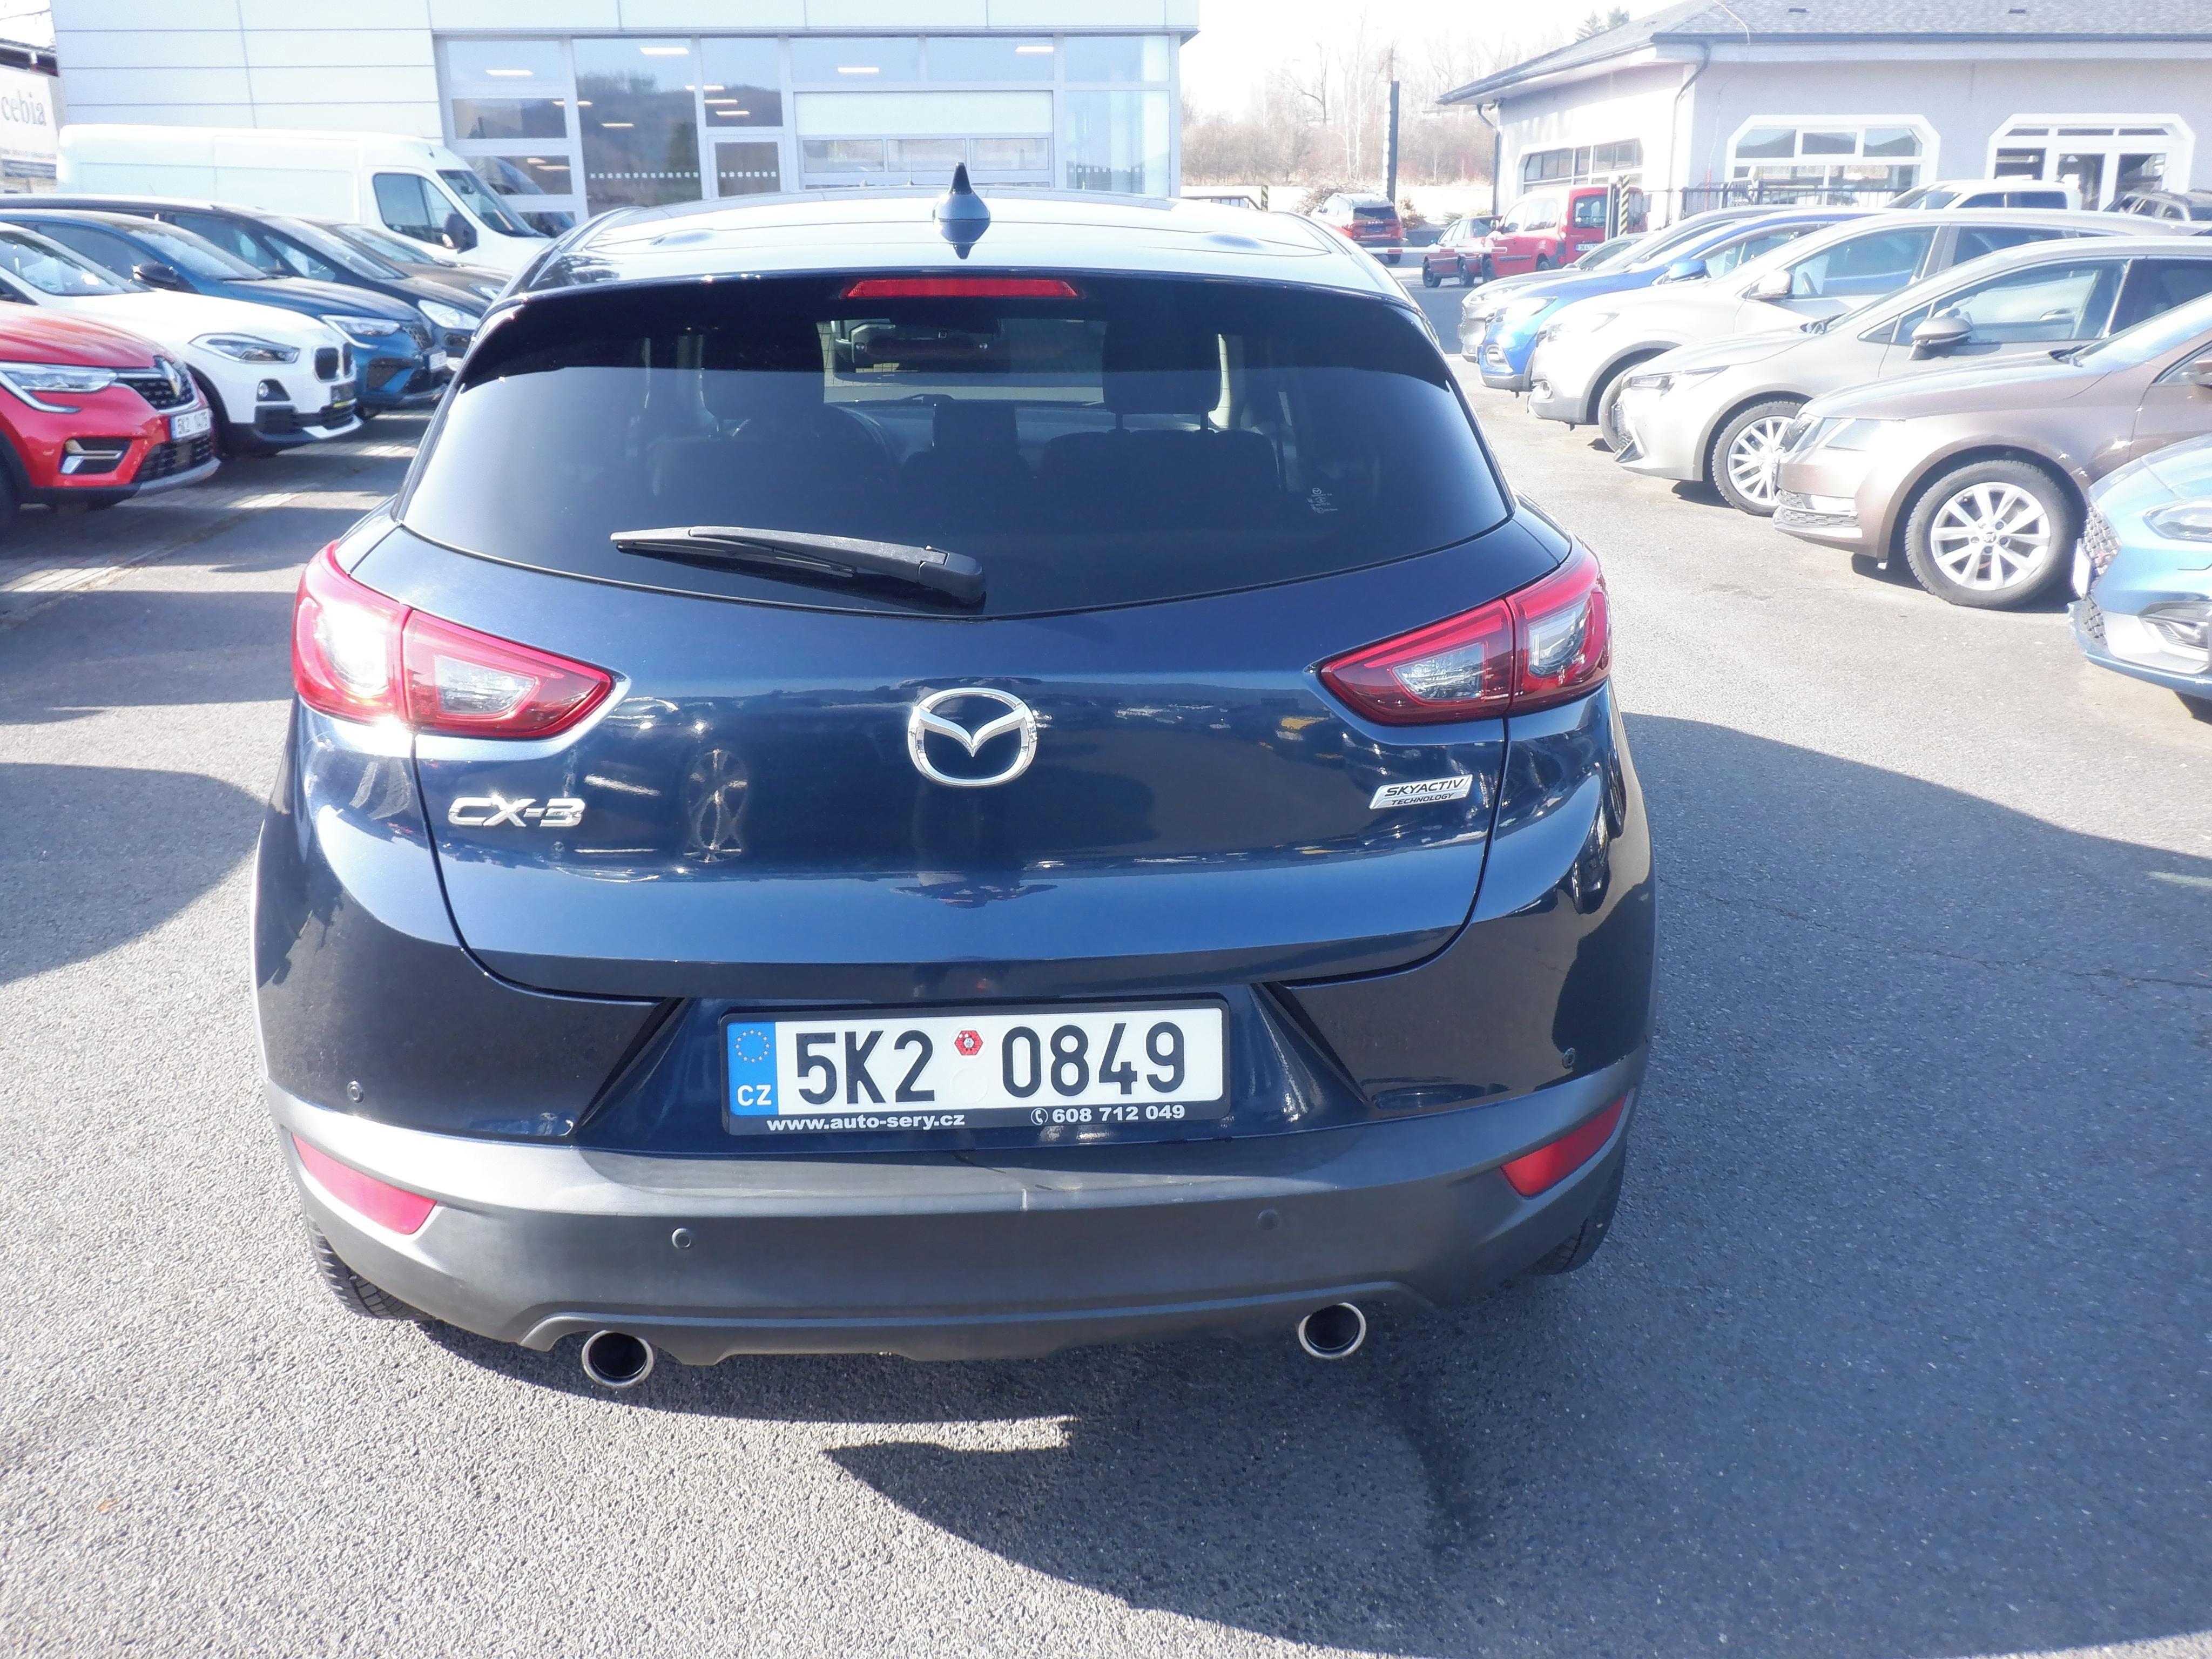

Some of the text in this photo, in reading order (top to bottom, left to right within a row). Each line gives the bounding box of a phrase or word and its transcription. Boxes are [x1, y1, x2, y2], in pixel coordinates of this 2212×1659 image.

[1, 89, 47, 126] cebia
[1384, 778, 1465, 797] SKYACTIV
[1391, 792, 1455, 806] TECHNOLOGY
[448, 796, 586, 827] CX-3
[795, 1021, 1185, 1105] 5K2 0849
[737, 1084, 772, 1107] CZ
[766, 1114, 966, 1131] www.auto-sery.cz
[1051, 1104, 1185, 1123] 608 712 049
